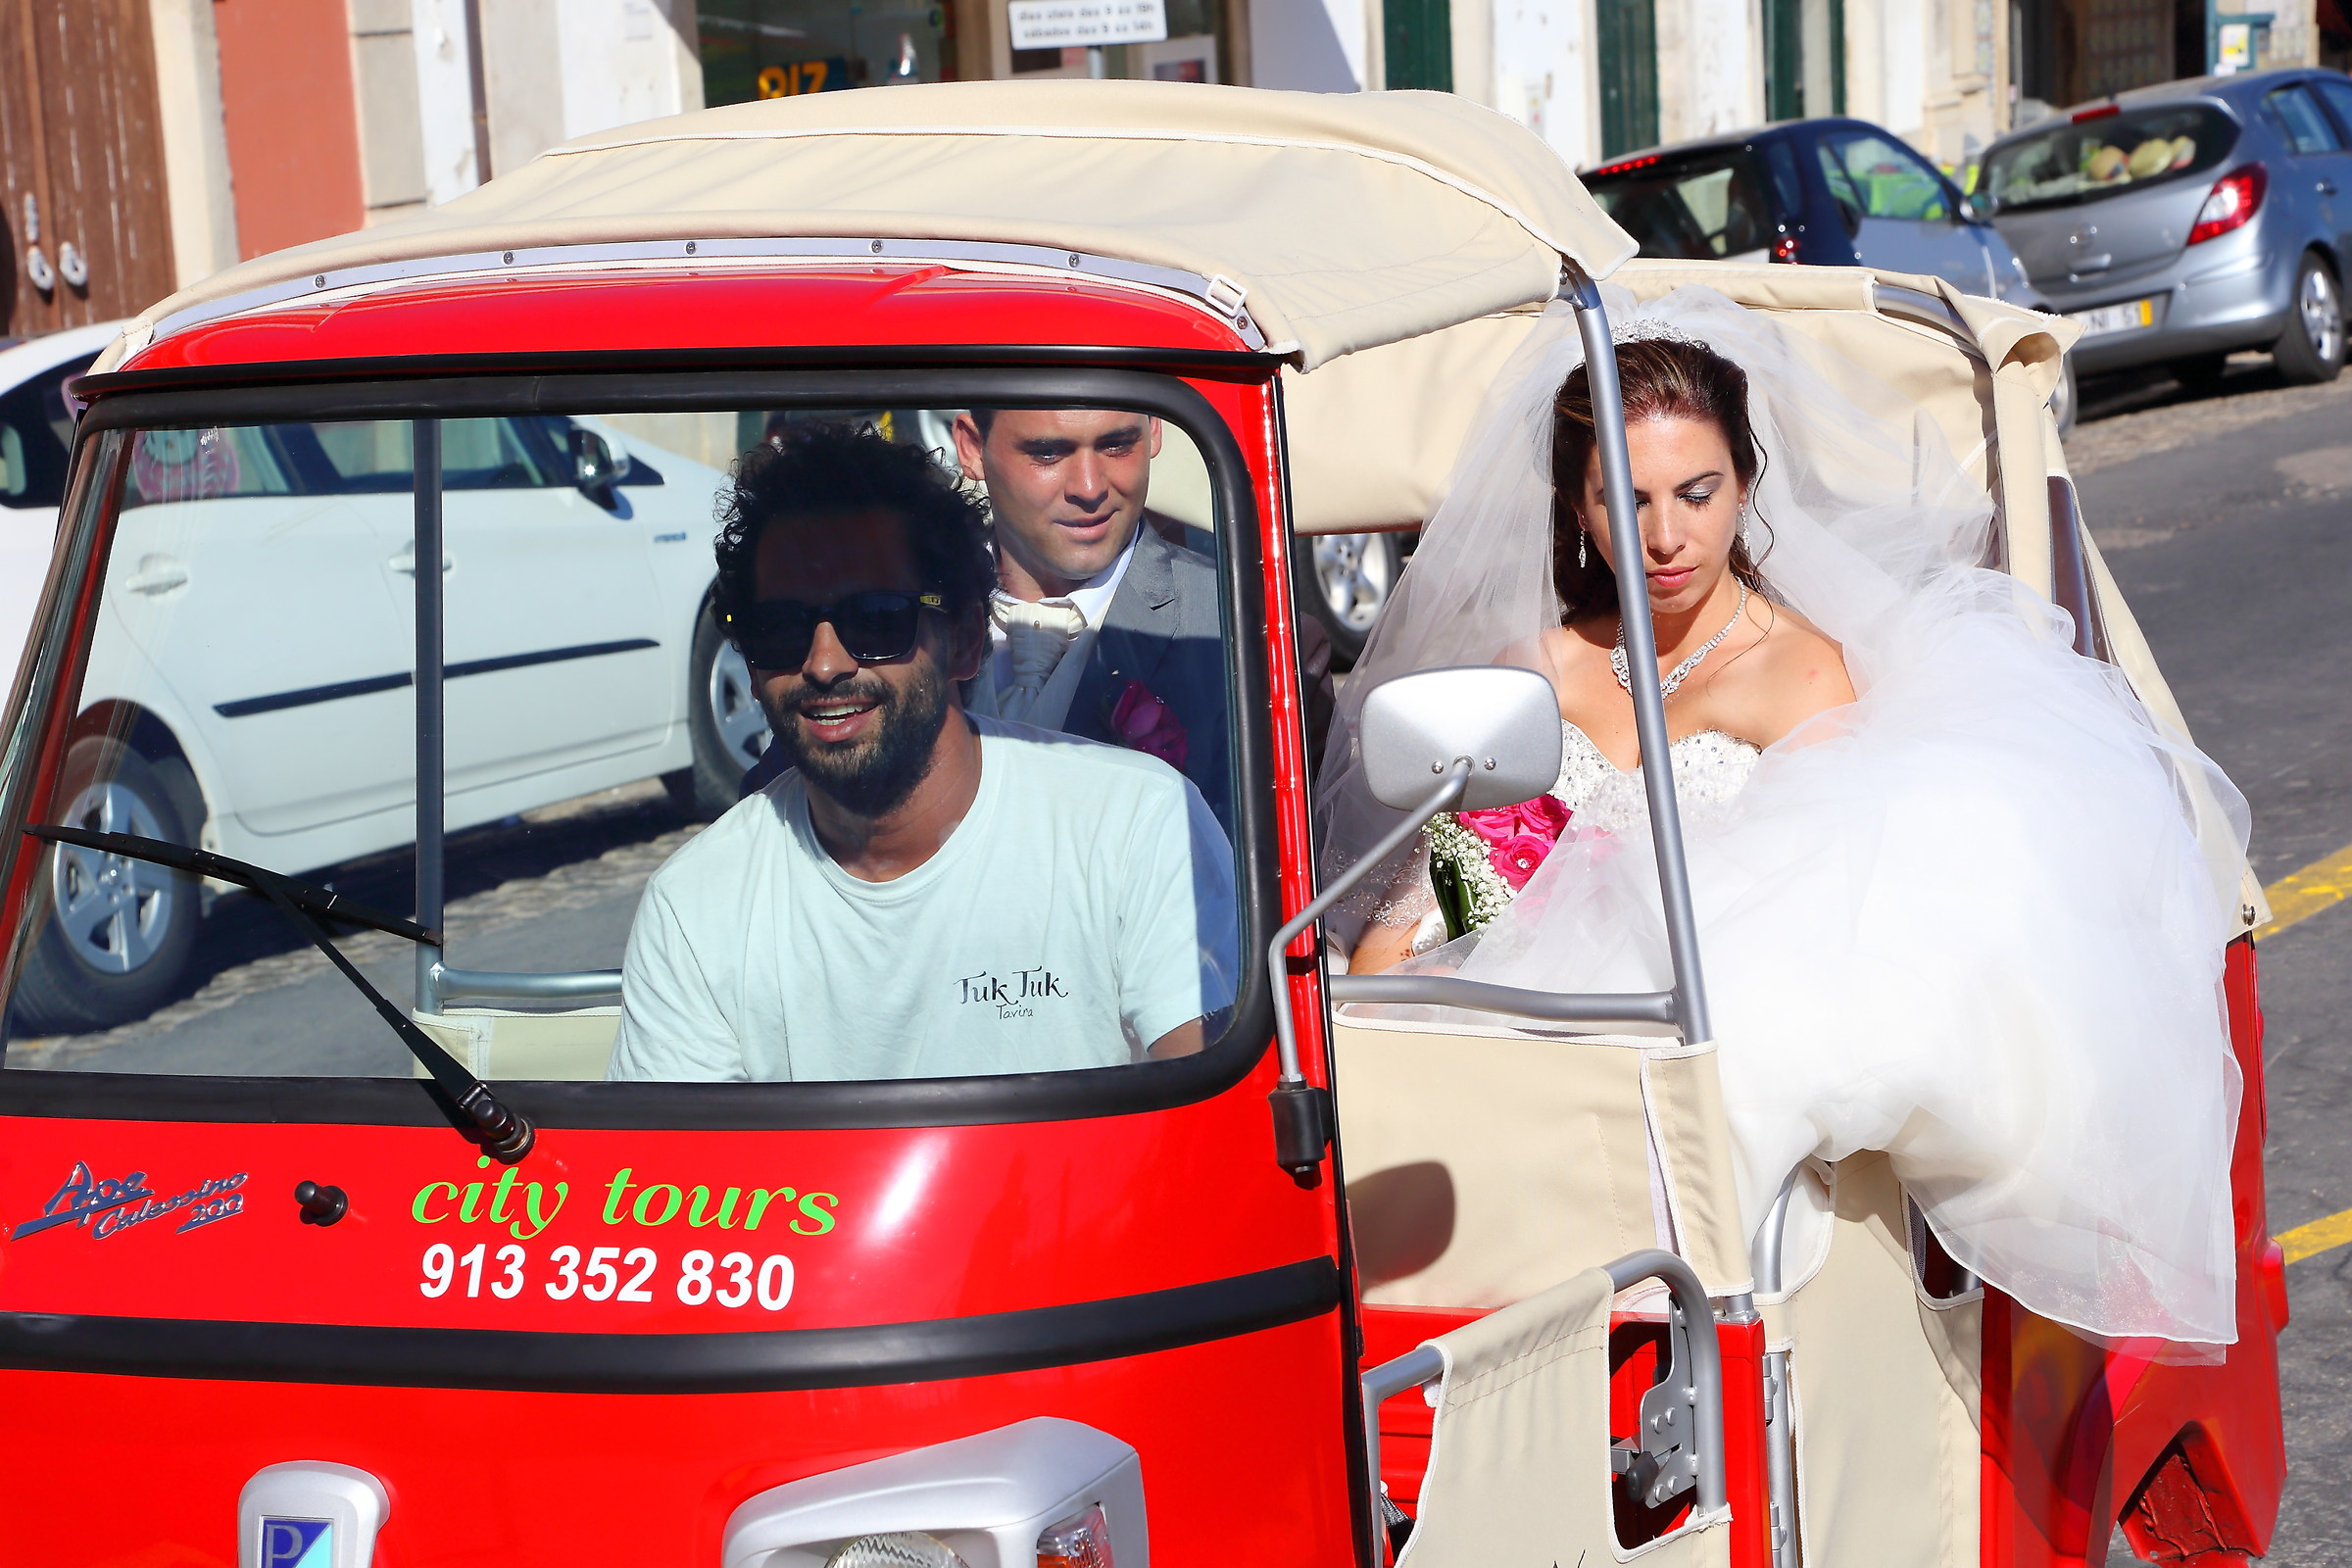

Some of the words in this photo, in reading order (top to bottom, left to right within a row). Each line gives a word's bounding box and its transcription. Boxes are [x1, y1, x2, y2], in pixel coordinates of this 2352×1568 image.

[954, 971, 1018, 1005] Tuk
[1012, 965, 1068, 998] Tuk
[996, 1003, 1034, 1019] Tavira
[29, 1160, 154, 1233] Ape
[92, 1172, 248, 1240] Calessino
[186, 1194, 244, 1227] 200
[411, 1154, 569, 1240] city
[602, 1167, 839, 1236] tours
[419, 1243, 526, 1300] 913
[545, 1245, 658, 1303] 352
[676, 1249, 795, 1311] 830
